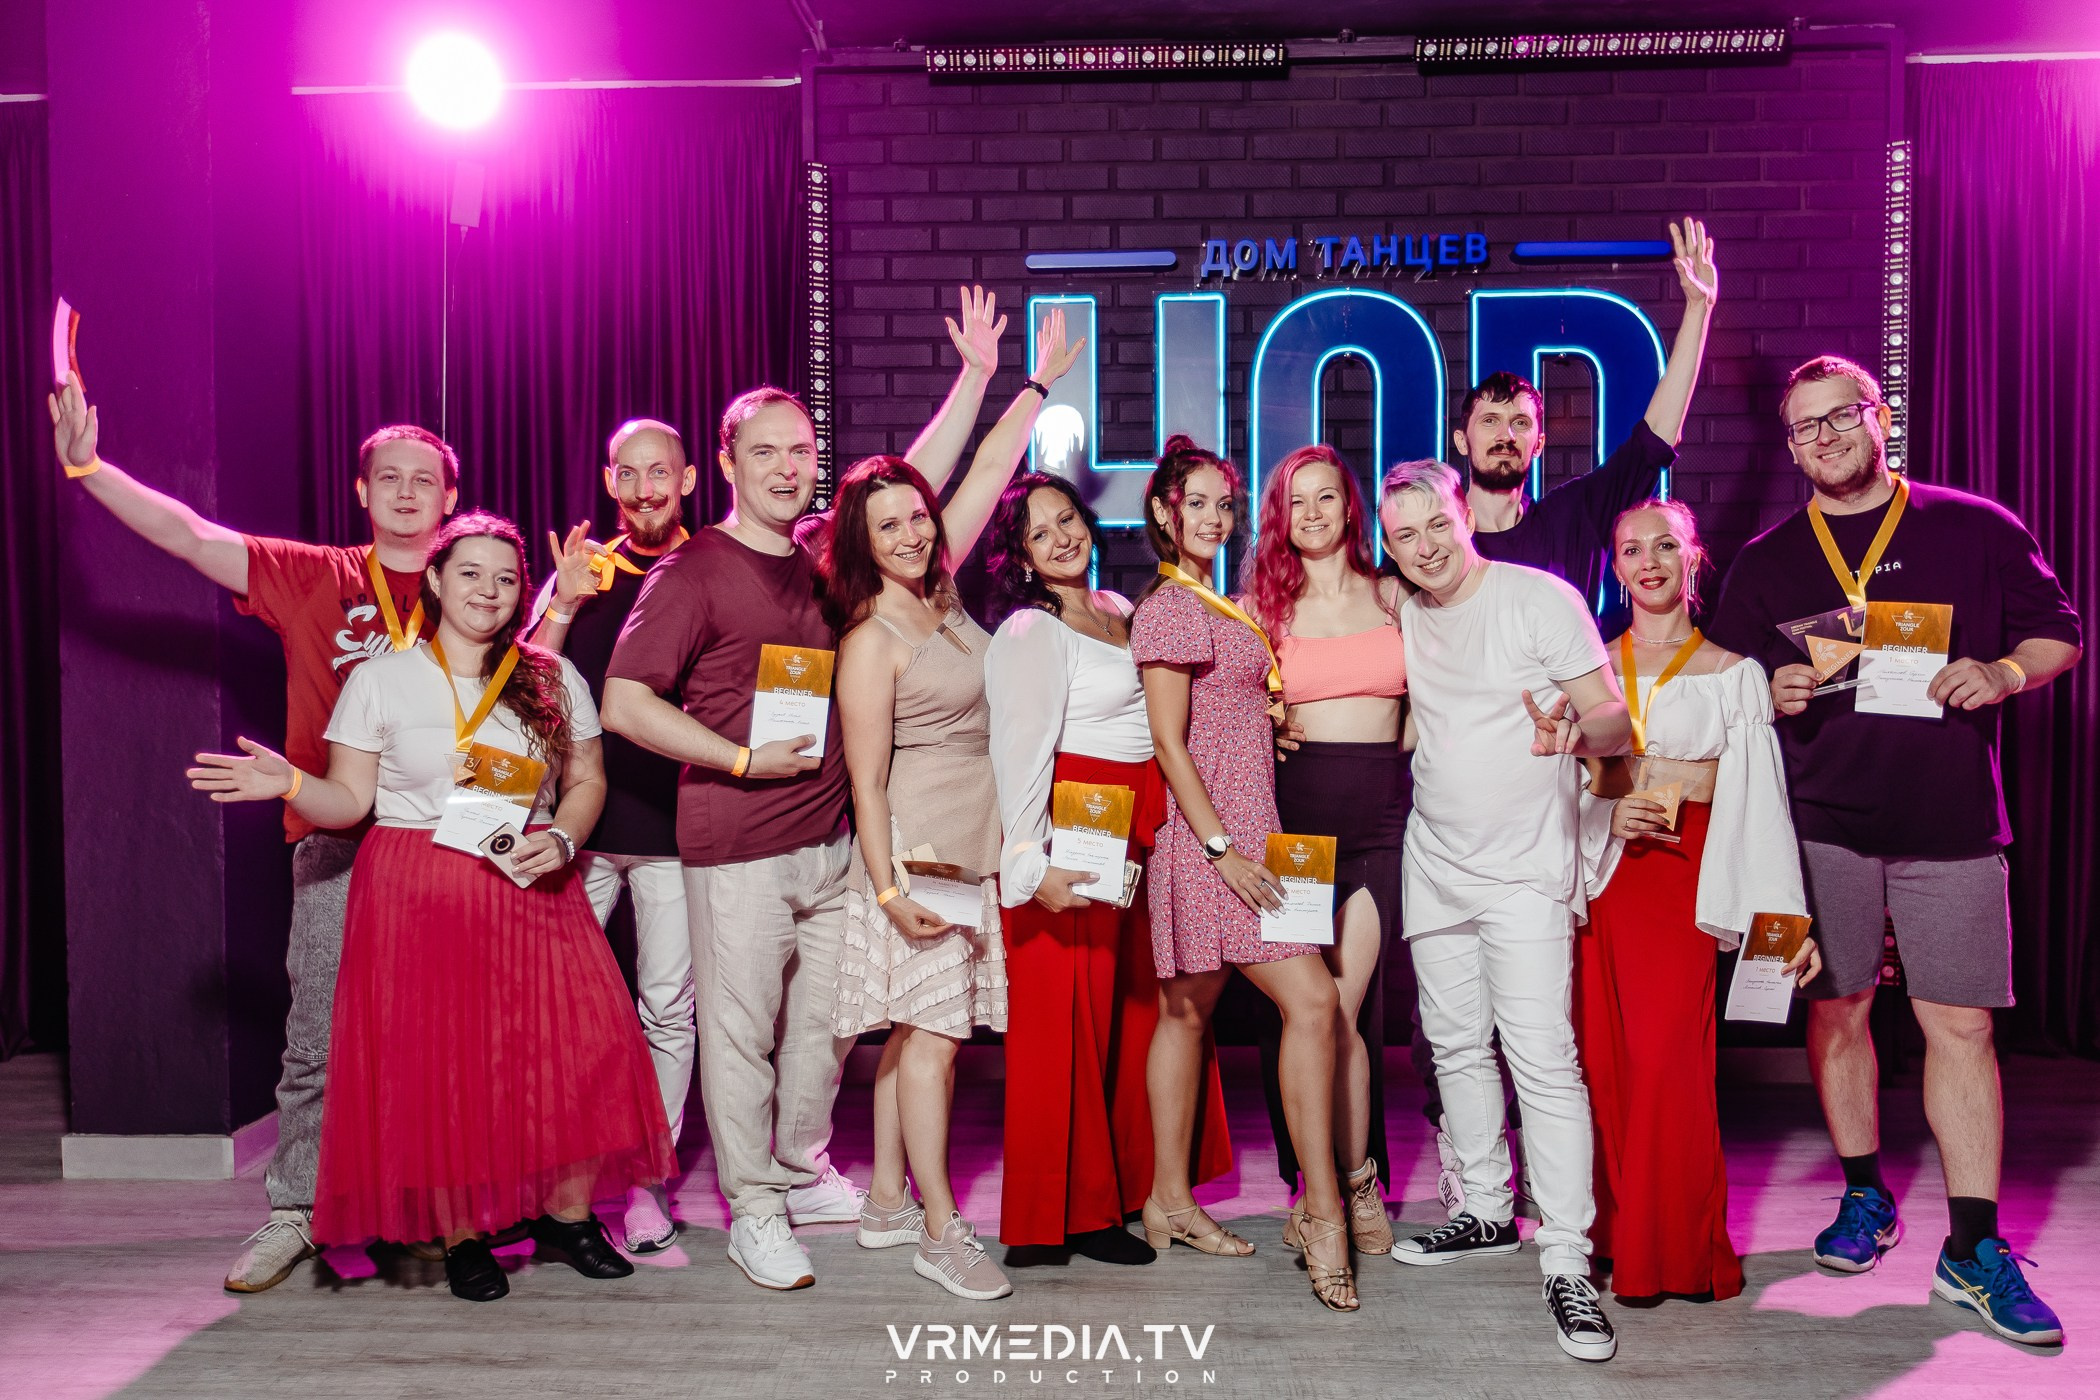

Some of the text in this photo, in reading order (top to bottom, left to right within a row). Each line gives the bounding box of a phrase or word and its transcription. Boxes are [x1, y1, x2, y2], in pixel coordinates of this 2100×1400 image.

[1201, 232, 1488, 278] ДОМ ТАНЦЕВ
[1882, 644, 1928, 654] BEGINNER
[1823, 649, 1856, 676] BEGINNER
[773, 687, 813, 697] BEGINNER
[467, 757, 474, 768] 3
[473, 785, 513, 803] BEGINNER
[1073, 825, 1112, 838] BEGINNER
[1280, 876, 1318, 884] BEGINNER
[1753, 955, 1784, 963] BEGINNER
